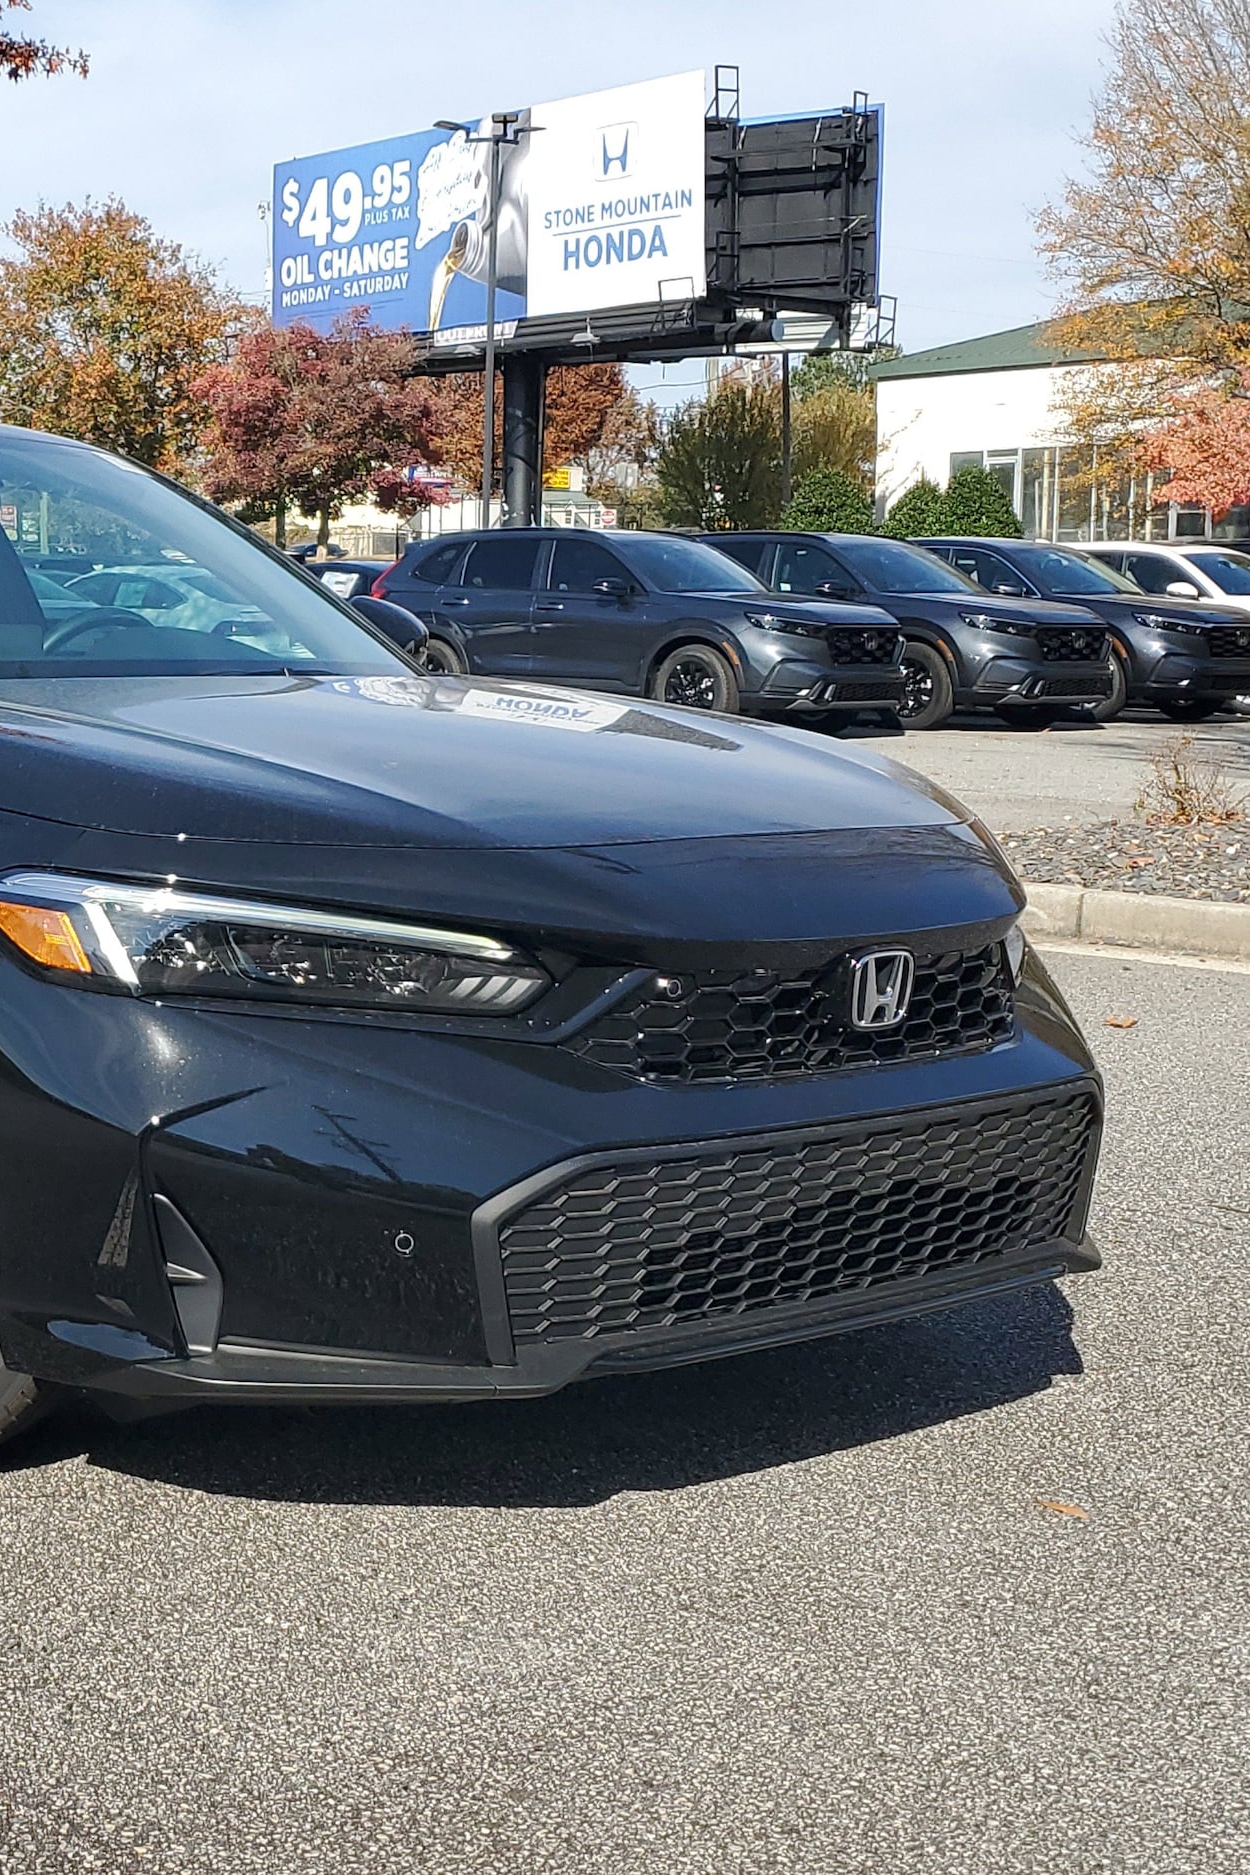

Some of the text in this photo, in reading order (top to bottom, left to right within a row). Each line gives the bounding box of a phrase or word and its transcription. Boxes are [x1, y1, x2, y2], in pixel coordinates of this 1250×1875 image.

[364, 205, 410, 226] PLUS TAX
[544, 188, 692, 229] STONE MOUNTAIN
[280, 236, 409, 287] OIL CHANGE
[563, 224, 668, 271] HONDA
[282, 284, 331, 308] MONDAY
[342, 272, 409, 298] SATURDAY
